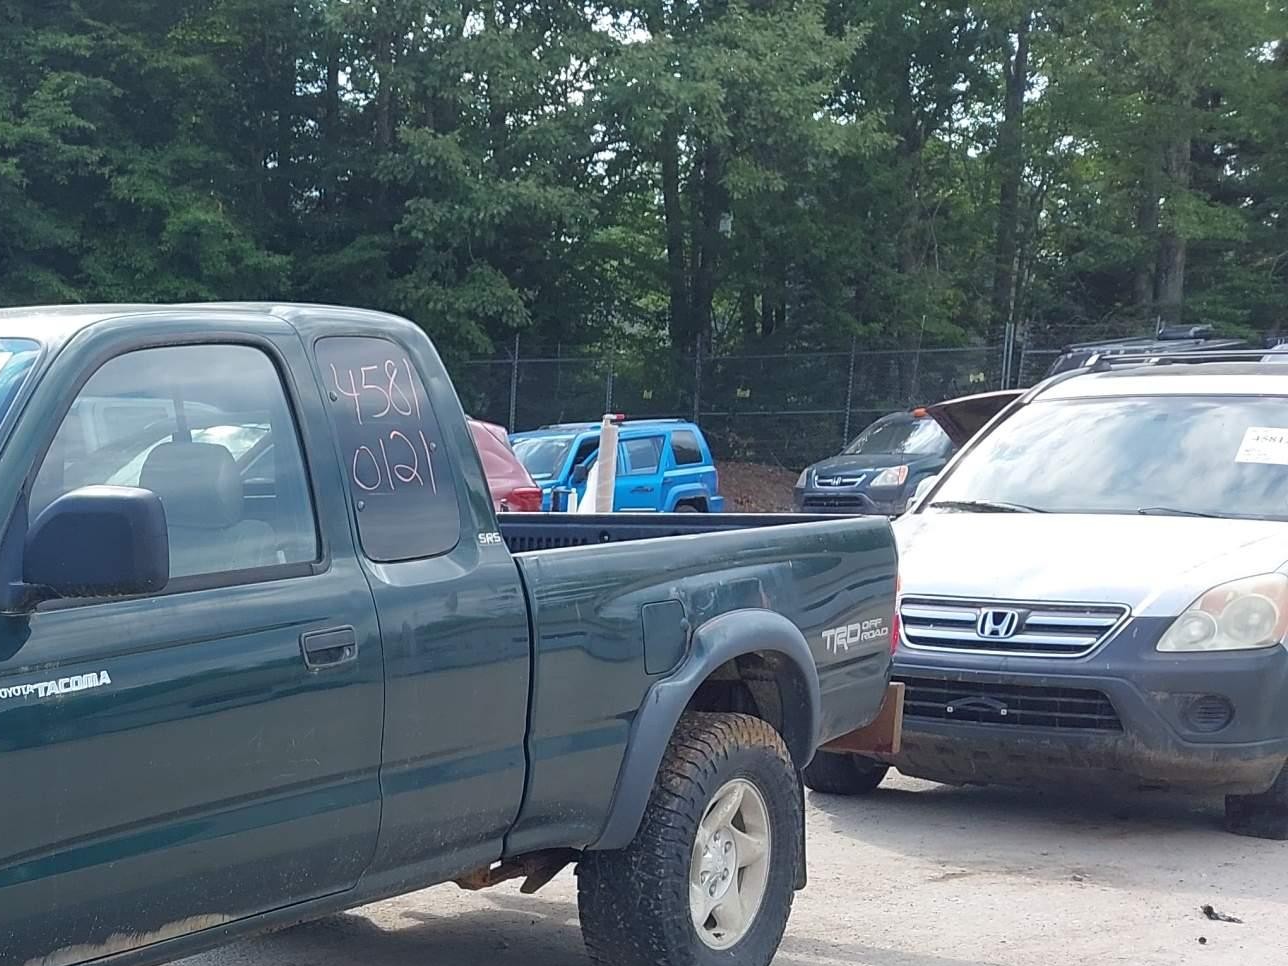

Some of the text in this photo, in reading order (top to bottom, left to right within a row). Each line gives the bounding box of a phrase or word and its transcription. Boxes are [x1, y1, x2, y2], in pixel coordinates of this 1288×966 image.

[330, 357, 421, 425] 4581
[352, 430, 437, 495] 0121
[822, 618, 882, 654] TRD OFF
[861, 627, 888, 640] ROAD
[34, 671, 111, 697] TACOMA
